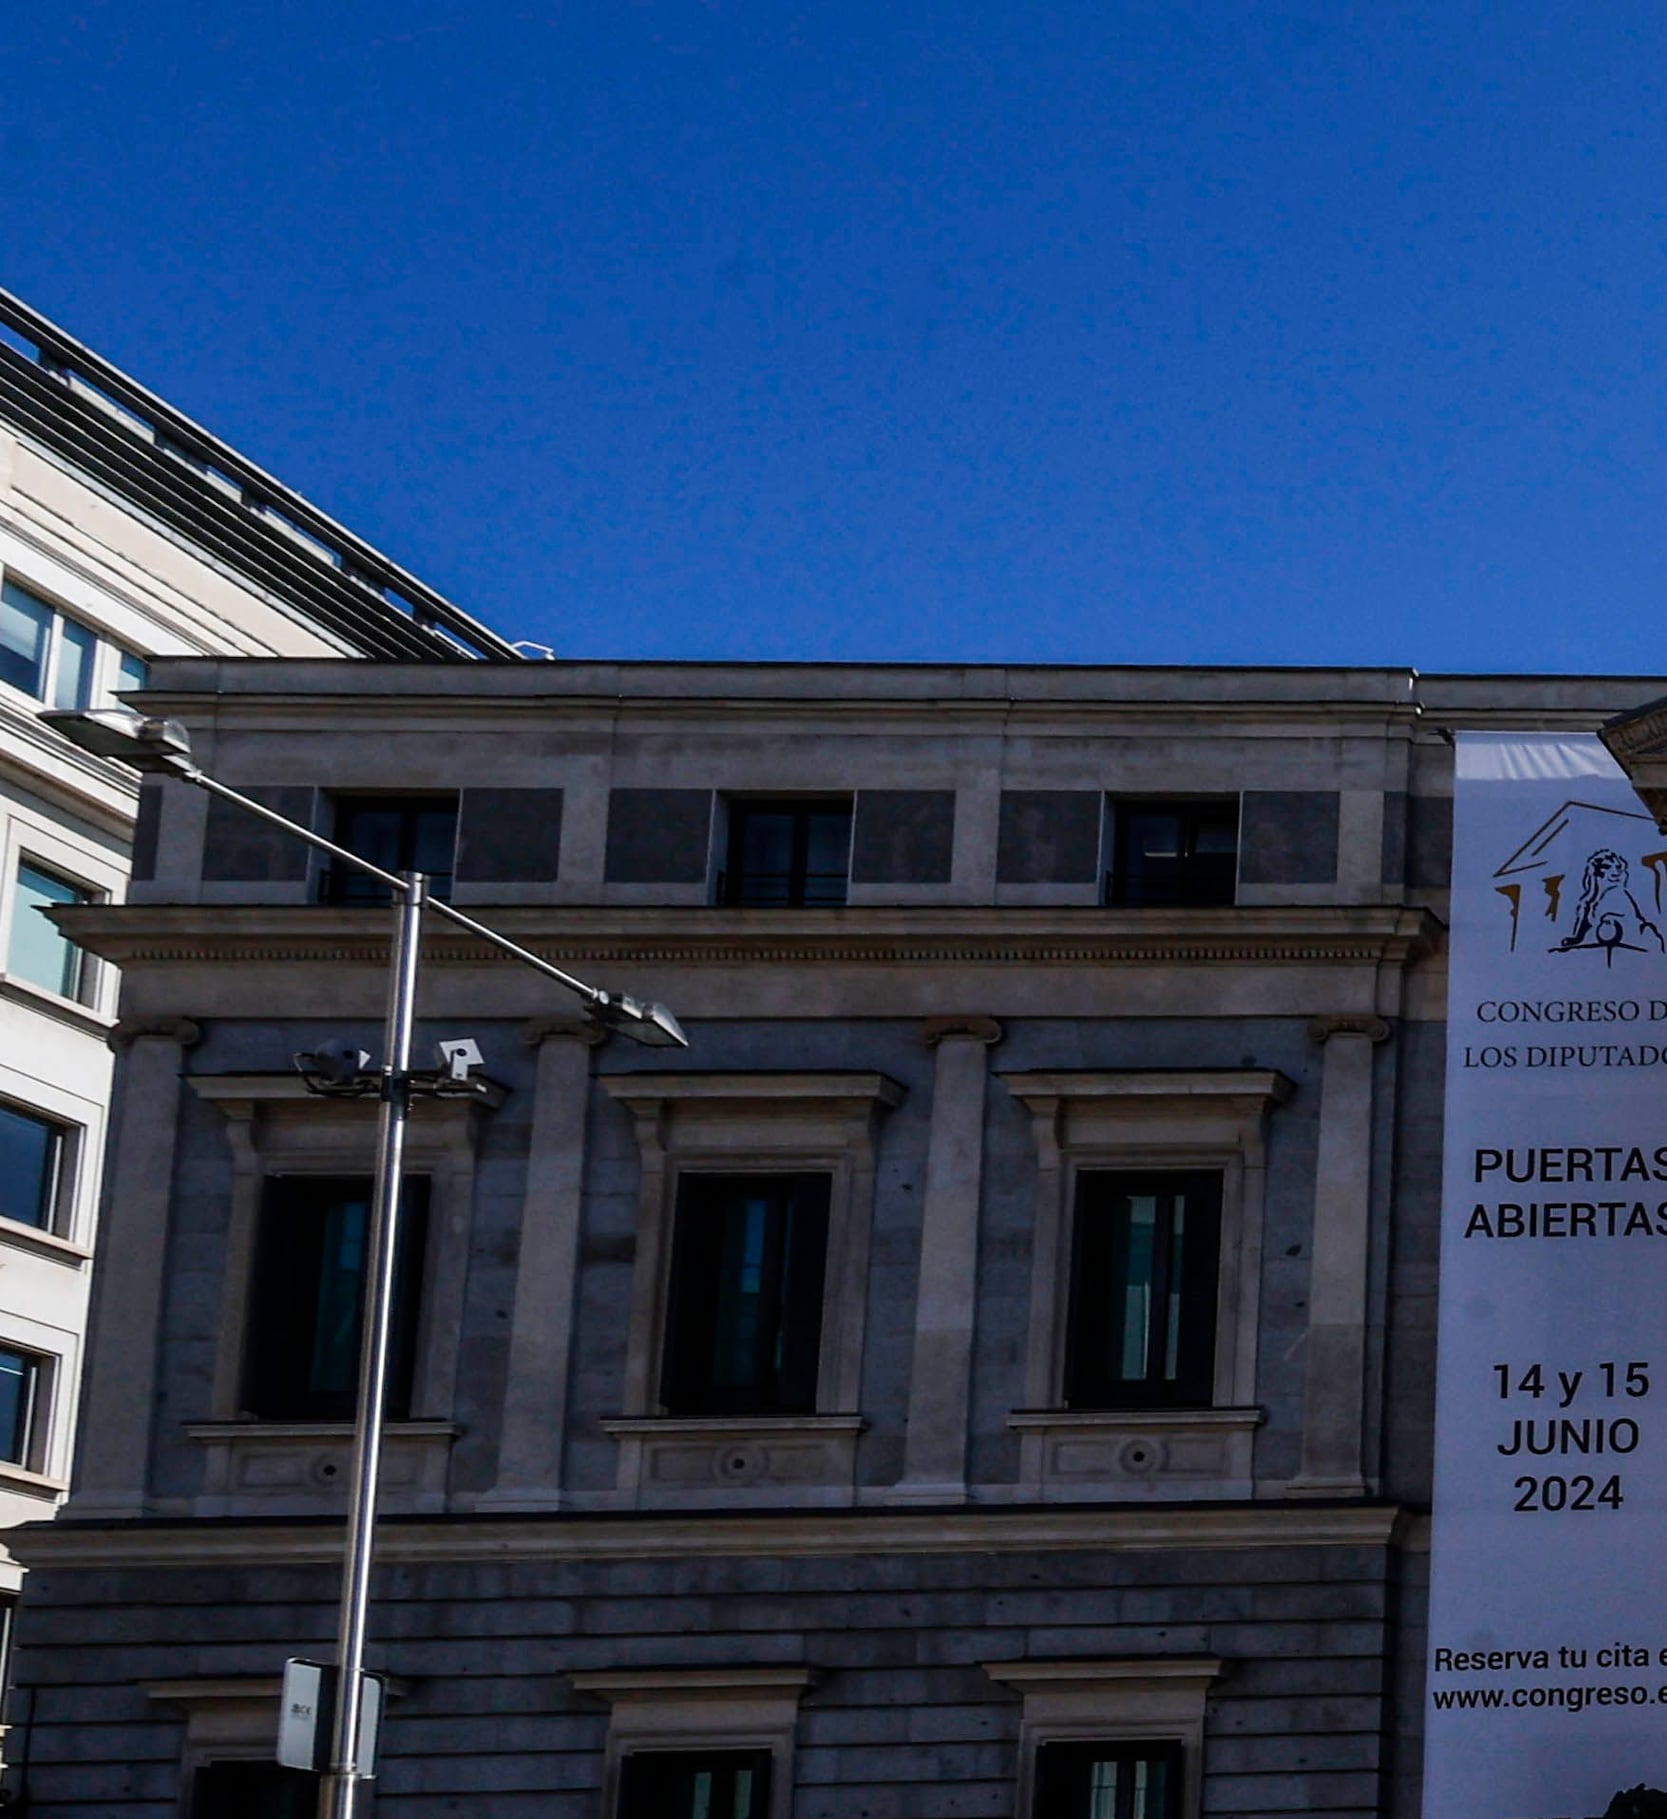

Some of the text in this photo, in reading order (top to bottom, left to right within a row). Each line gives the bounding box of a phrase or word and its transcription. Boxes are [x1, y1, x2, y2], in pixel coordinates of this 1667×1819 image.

[1476, 1000, 1640, 1023] CONGRESO
[1464, 1046, 1518, 1068] LOS
[1493, 1362, 1650, 1408] 14 y 15
[1497, 1418, 1639, 1456] JUNIO
[1513, 1474, 1624, 1512] 2024
[1434, 1648, 1549, 1672] Reserva
[1557, 1646, 1587, 1669] tu
[1596, 1641, 1650, 1668] cita
